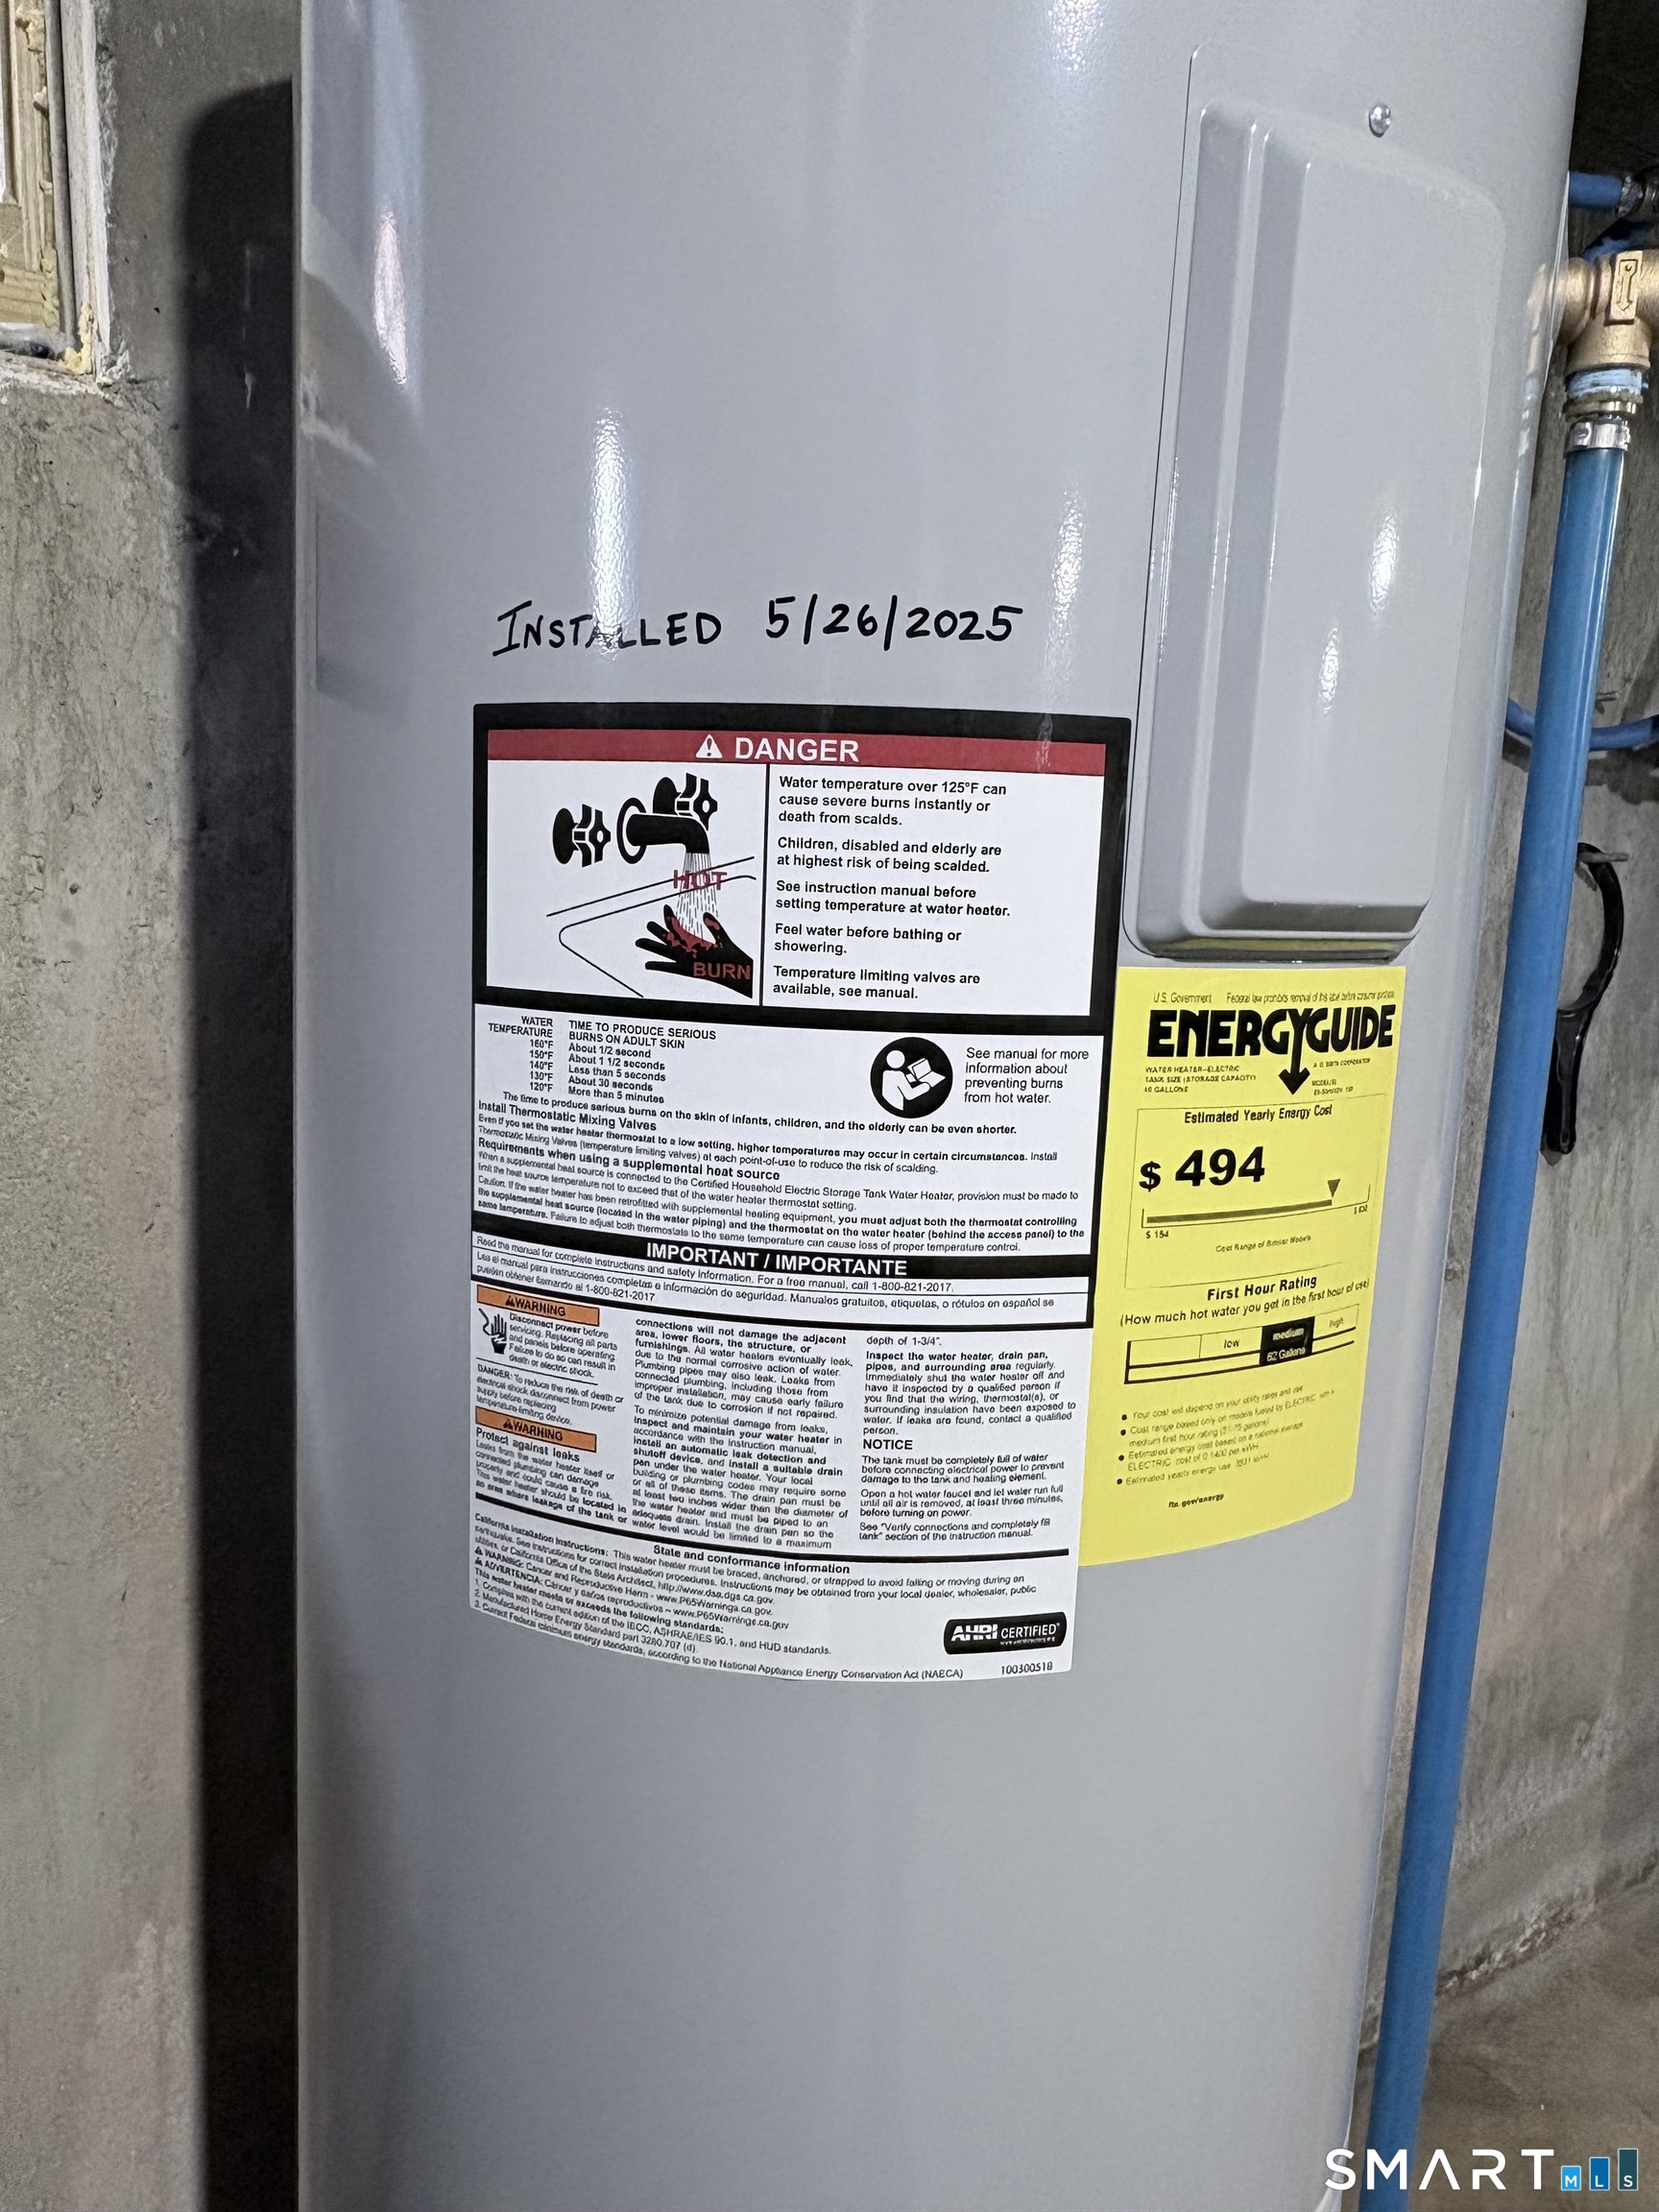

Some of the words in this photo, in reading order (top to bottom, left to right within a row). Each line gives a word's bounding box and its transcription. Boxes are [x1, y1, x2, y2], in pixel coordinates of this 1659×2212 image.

[766, 593, 1023, 651] 5/26/2025
[735, 736, 859, 762] DANGER
[780, 776, 818, 788] Water
[822, 778, 902, 792] temperature
[907, 782, 938, 792] over
[942, 781, 979, 794] 125°F
[983, 785, 1006, 795] can
[780, 796, 818, 805] cause
[823, 797, 866, 806] severe
[872, 796, 910, 808] burns
[915, 798, 972, 813] instantly
[976, 803, 991, 811] or
[779, 810, 815, 822] death
[819, 811, 850, 824] from
[854, 813, 902, 826] scalds.
[778, 837, 837, 852] Children,
[842, 839, 899, 852] disabled
[902, 842, 927, 853] and
[931, 843, 976, 857] elderly
[981, 847, 1001, 855] are
[778, 854, 789, 865] at
[794, 854, 843, 869] highest
[847, 856, 872, 868] risk
[876, 857, 890, 869] of
[893, 858, 929, 873] being
[934, 860, 989, 872] scalded.
[673, 870, 727, 890] HOT
[777, 880, 800, 892] See
[805, 881, 876, 895] instruction
[881, 885, 929, 897] manual
[934, 885, 976, 898] before
[776, 898, 820, 912] setting
[825, 900, 906, 914] temperature
[910, 902, 922, 913] at
[926, 903, 963, 914] water
[967, 903, 1010, 916] heater.
[776, 923, 802, 935] Feel
[806, 926, 843, 936] water
[847, 926, 889, 938] before
[893, 927, 943, 943] bathing
[948, 932, 962, 941] or
[775, 940, 847, 956] showering.
[693, 962, 751, 979] BURN
[774, 966, 855, 979] Temperature
[860, 969, 908, 984] limiting
[913, 972, 955, 983] valves
[773, 983, 834, 997] available,
[839, 987, 862, 997] see
[866, 987, 918, 998] manual.
[488, 1022, 553, 1038] TEMPERATURE
[521, 1016, 553, 1027] WATER
[568, 1020, 592, 1030] TIME
[595, 1022, 609, 1031] TO
[613, 1023, 664, 1036] PRODUCE
[668, 1027, 716, 1040] SERIOUS
[1146, 1004, 1396, 1057] ENERGYGUIDE
[569, 1031, 603, 1043] BURNS
[606, 1034, 620, 1045] ON
[622, 1036, 657, 1046] ADULT
[660, 1039, 685, 1048] SKIN
[568, 1043, 596, 1053] About
[599, 1046, 613, 1055] 1/2
[615, 1048, 651, 1058] second
[967, 1047, 990, 1058] See
[995, 1048, 1037, 1059] manual
[1041, 1048, 1057, 1059] for
[1060, 1051, 1089, 1060] more
[568, 1053, 596, 1064] About
[599, 1056, 603, 1066] 1
[608, 1057, 620, 1067] 1/2
[624, 1060, 665, 1070] seconds
[966, 1062, 1031, 1073] information
[1035, 1064, 1068, 1073] about
[568, 1064, 589, 1074] Less
[592, 1068, 613, 1077] than
[616, 1069, 622, 1077] 5
[624, 1071, 666, 1081] seconds
[568, 1075, 596, 1086] About
[598, 1078, 609, 1088] 30
[613, 1081, 653, 1092] seconds
[965, 1077, 1027, 1091] preventing
[1031, 1077, 1063, 1089] burns
[568, 1086, 590, 1096] More
[593, 1089, 614, 1098] than
[616, 1091, 622, 1099] 5
[625, 1093, 664, 1104] minutes
[964, 1092, 991, 1102] from
[996, 1093, 1013, 1103] hot
[479, 1100, 506, 1114] Install
[509, 1104, 576, 1122] Thermostatic
[579, 1113, 615, 1129] Mixing
[618, 1118, 657, 1131] Valves
[478, 1137, 544, 1157] Requirements
[547, 1149, 576, 1161] when
[580, 1153, 610, 1167] using
[613, 1158, 619, 1166] a
[623, 1160, 703, 1175] supplemental
[707, 1165, 733, 1177] heat
[737, 1169, 780, 1180] source
[1139, 1161, 1161, 1192] $
[1175, 1146, 1265, 1187] 494
[646, 1241, 759, 1268] IMPORTANT
[776, 1254, 907, 1277] IMPORTANTE
[586, 1285, 655, 1302] 1-800-821-2017
[1292, 1295, 1306, 1306] the
[1346, 1282, 1354, 1293] of
[515, 1297, 565, 1316] WARNING
[866, 1351, 903, 1361] Inspect
[908, 1352, 924, 1360] the
[998, 1351, 1022, 1359] drain
[513, 1421, 564, 1441] WARNING
[863, 1438, 913, 1450] NOTICE
[654, 1545, 681, 1557] State
[684, 1551, 704, 1561] and
[708, 1555, 781, 1570] conformance
[783, 1561, 850, 1574] information
